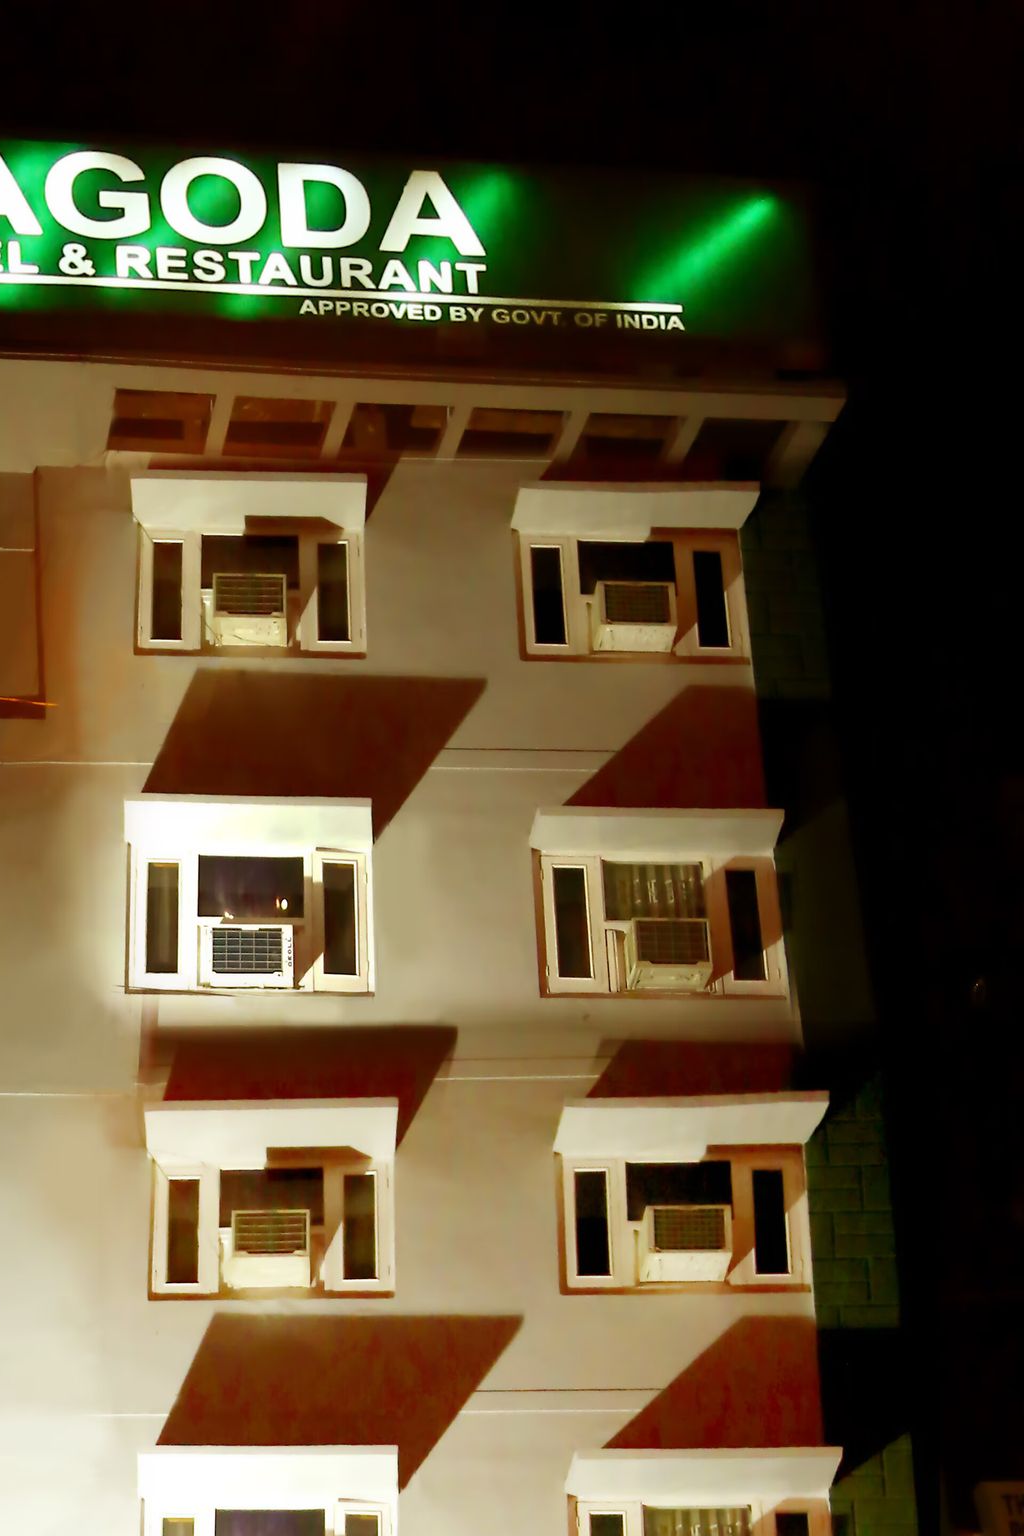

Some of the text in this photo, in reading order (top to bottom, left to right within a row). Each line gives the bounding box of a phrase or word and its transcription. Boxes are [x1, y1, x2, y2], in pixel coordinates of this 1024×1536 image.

[58, 242, 96, 276] &
[115, 244, 487, 294] RESTAURANT
[299, 298, 442, 321] APPROVED
[449, 305, 484, 322] BY
[574, 312, 608, 327] OF
[616, 314, 686, 331] INDIA
